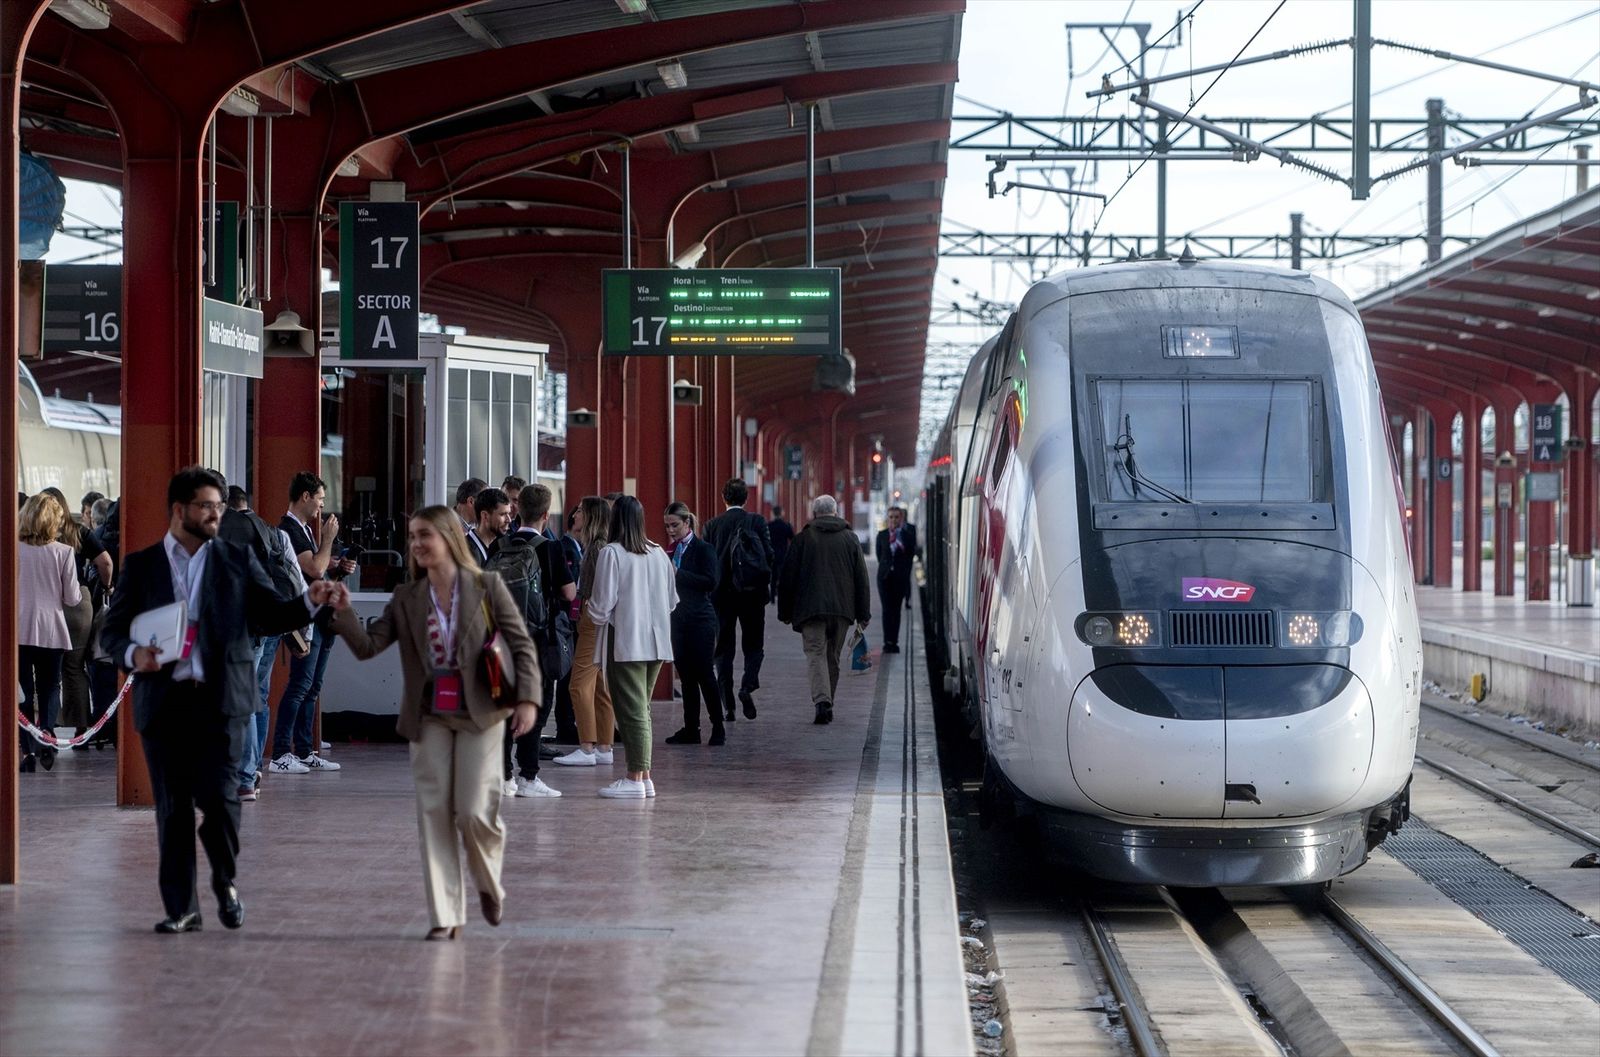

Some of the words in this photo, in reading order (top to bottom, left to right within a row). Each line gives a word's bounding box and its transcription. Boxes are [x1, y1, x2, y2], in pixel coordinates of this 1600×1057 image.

[357, 207, 369, 216] Vía
[371, 237, 409, 269] 17
[84, 280, 98, 289] Vía
[673, 276, 692, 285] Hora
[720, 276, 737, 285] Tren
[637, 286, 650, 294] Vía
[358, 295, 411, 310] SECTOR
[673, 303, 703, 312] Destino
[84, 312, 119, 342] 16
[372, 315, 397, 349] A
[632, 316, 668, 346] 17
[1535, 415, 1552, 431] 18
[1540, 446, 1551, 460] A
[1186, 586, 1251, 599] SNCF
